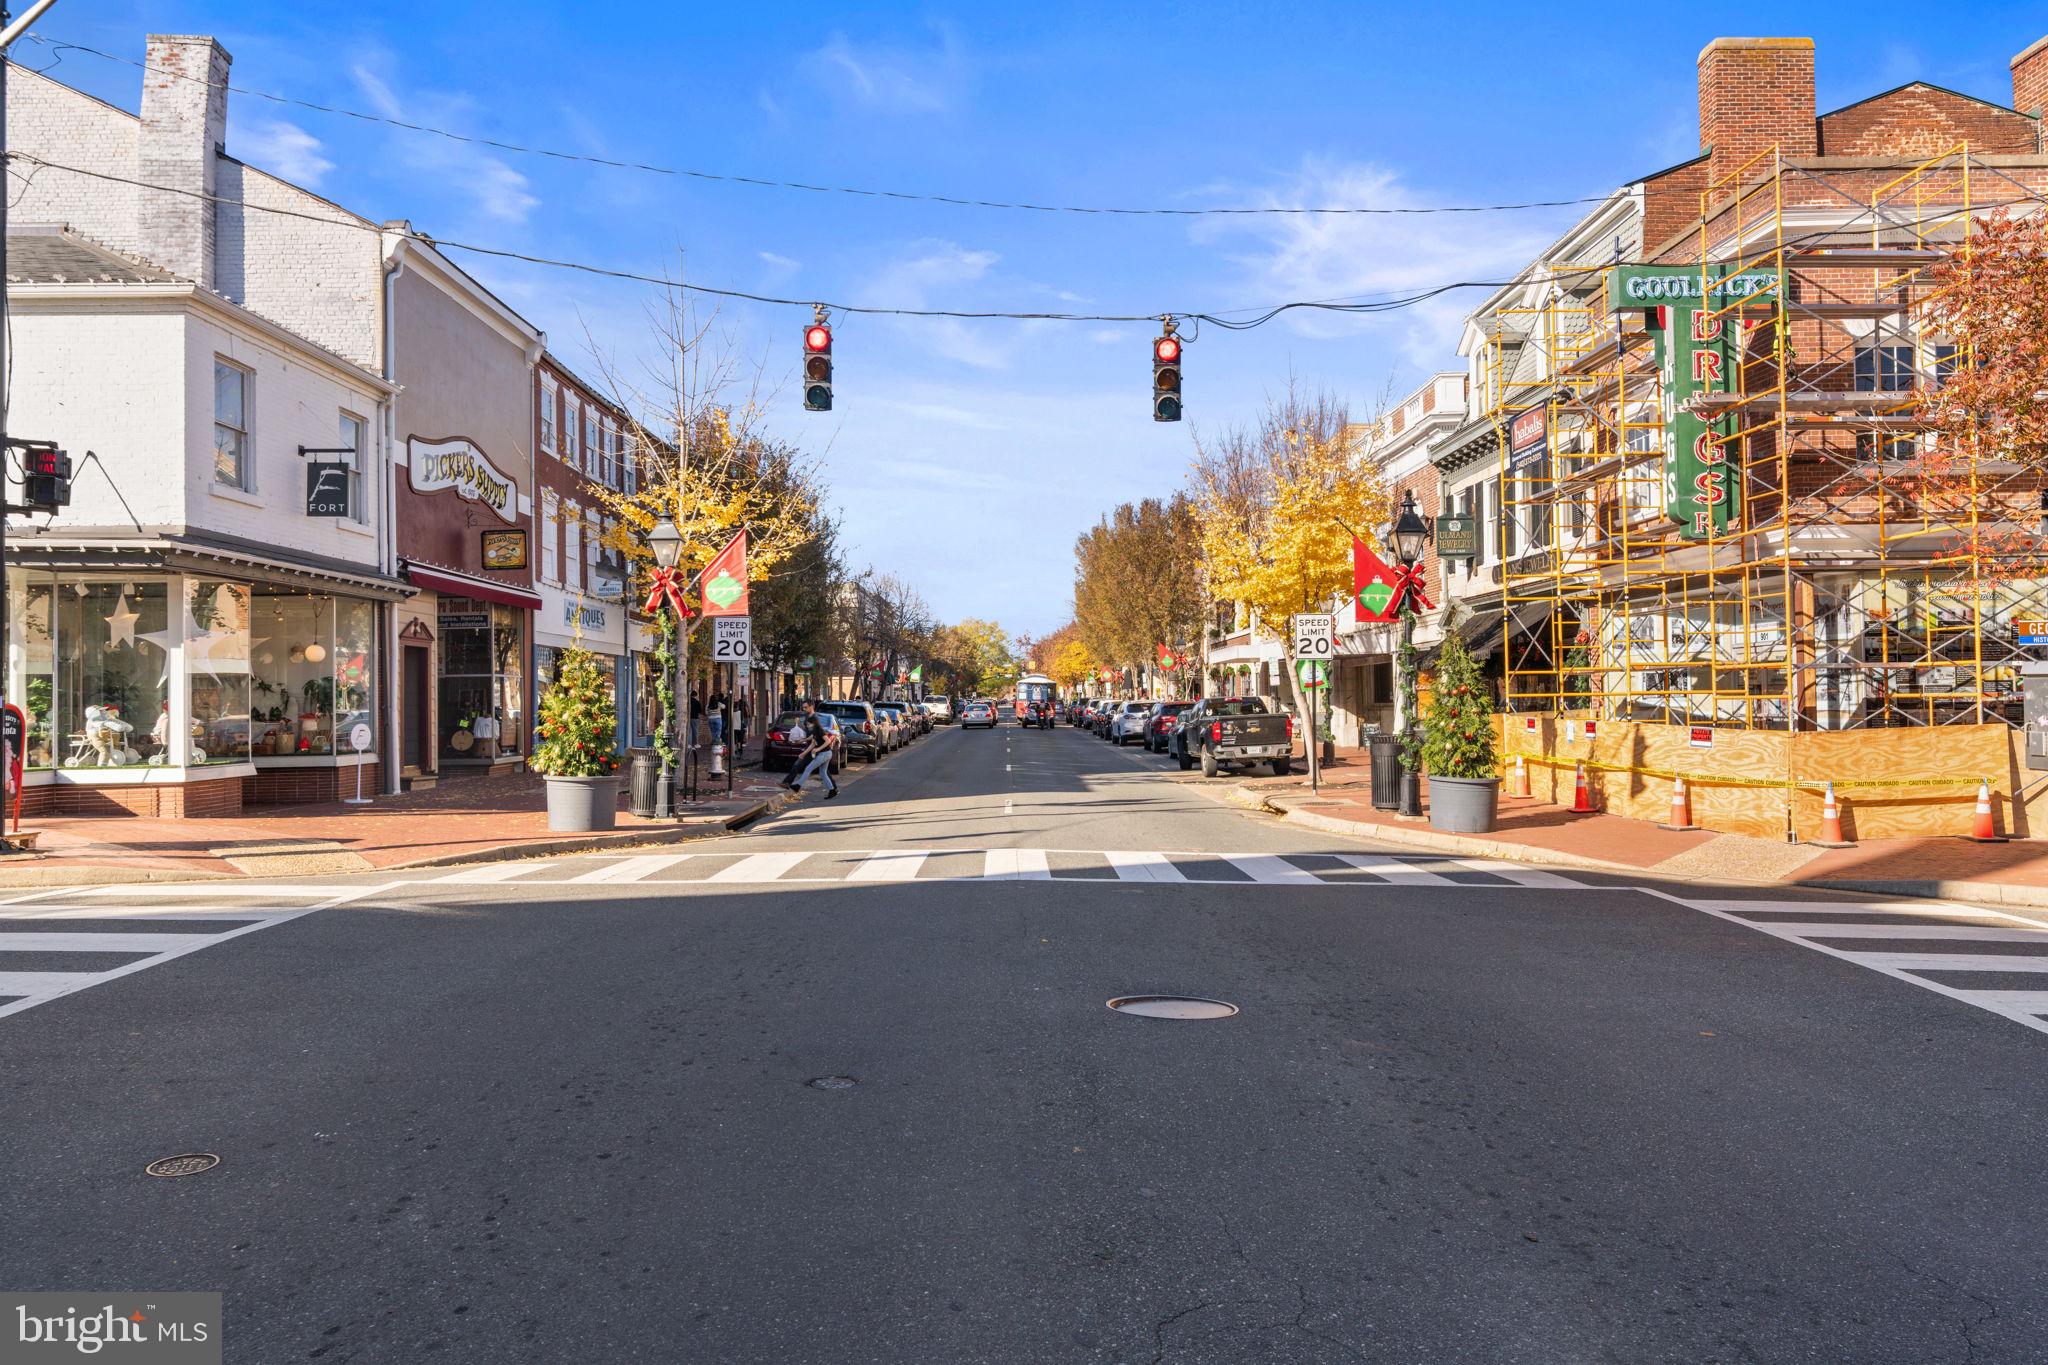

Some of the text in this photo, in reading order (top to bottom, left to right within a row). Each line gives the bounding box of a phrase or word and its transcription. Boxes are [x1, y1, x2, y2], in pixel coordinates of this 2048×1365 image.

[421, 444, 509, 510] PICKER'S SUPPLY
[309, 503, 345, 512] FORT
[1439, 540, 1473, 550] JEWELRY
[717, 621, 748, 629] SPEED
[1299, 619, 1329, 627] SPEED
[720, 630, 744, 638] LIMIT
[1302, 628, 1326, 636] LIMIT
[717, 639, 747, 656] 20
[1299, 637, 1329, 654] 20
